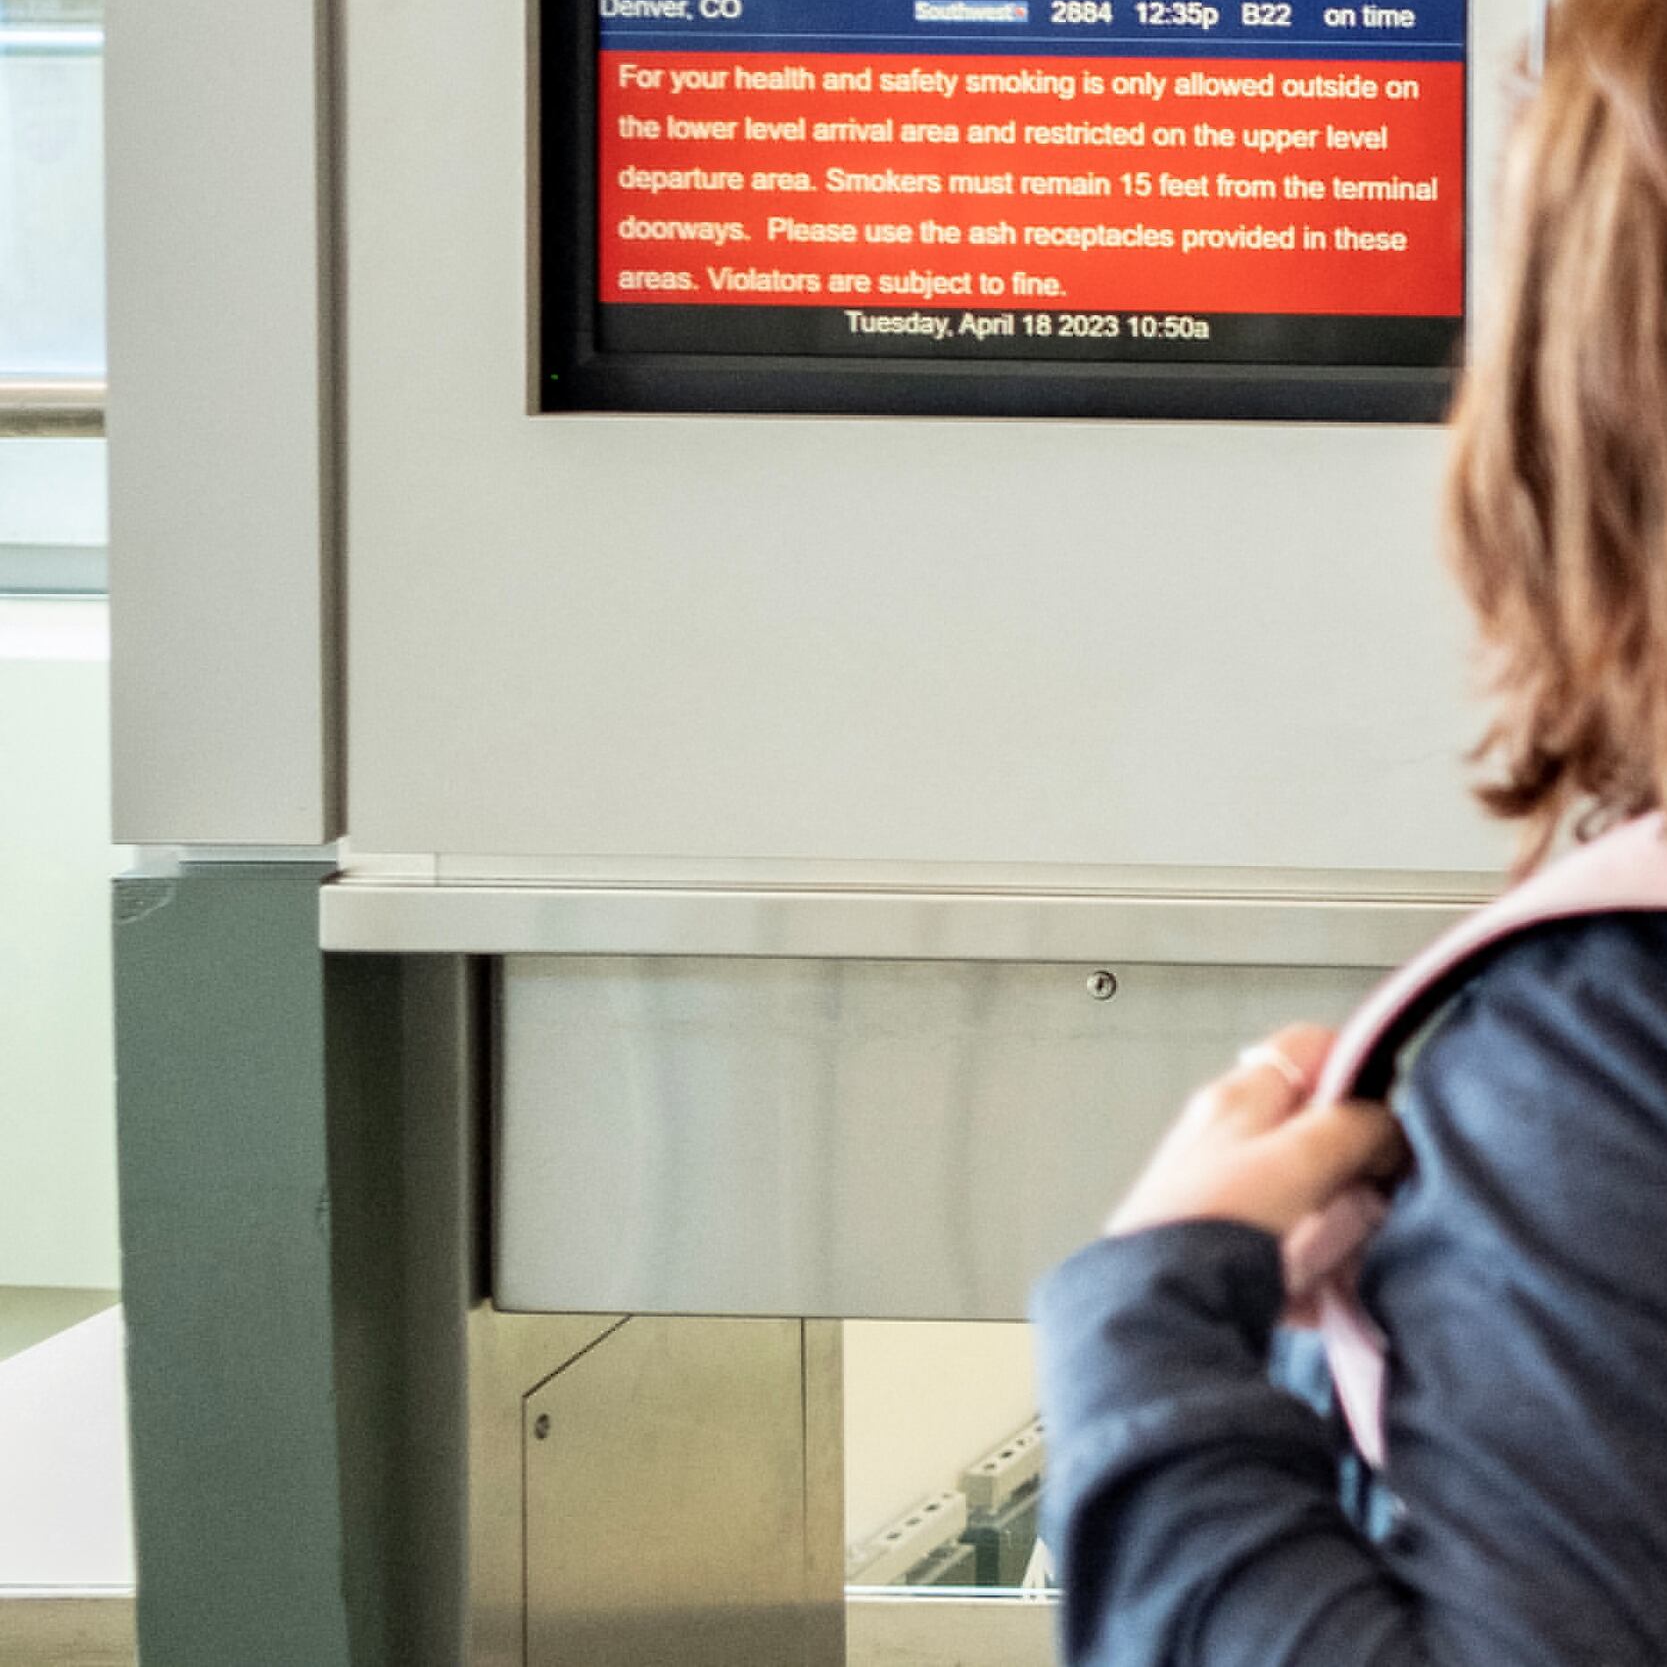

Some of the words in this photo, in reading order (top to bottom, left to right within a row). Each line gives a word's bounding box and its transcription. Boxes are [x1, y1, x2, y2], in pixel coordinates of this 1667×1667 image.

[619, 64, 664, 89] For
[670, 70, 730, 94] your
[734, 65, 816, 91] health
[822, 67, 873, 92] and
[879, 67, 959, 99] safety
[965, 69, 1076, 101] smoking
[1082, 70, 1105, 95] is
[1111, 71, 1167, 102] only
[1173, 71, 1275, 98] allowed
[1281, 73, 1379, 99] outside
[1385, 80, 1419, 99] on
[618, 115, 661, 139] the
[667, 115, 739, 140] lower
[744, 116, 806, 142] level
[812, 117, 894, 143] arrival
[899, 123, 960, 144] area
[966, 119, 1017, 145] and
[1023, 121, 1146, 147] restricted
[1151, 126, 1187, 147] on
[1193, 122, 1237, 148] the
[1242, 128, 1321, 154] upper
[1326, 124, 1388, 150] level
[618, 165, 745, 194] departure
[750, 171, 817, 192] area.
[825, 166, 943, 194] Smokers
[948, 171, 1015, 195] must
[1020, 171, 1112, 197] remain
[1119, 171, 1153, 197] 15
[1158, 171, 1210, 198] feet
[1215, 173, 1277, 199] from
[1283, 174, 1326, 200] the
[1332, 176, 1438, 201] terminal
[618, 215, 752, 247] doorways.
[767, 216, 859, 243] Please
[863, 223, 915, 244] use
[918, 218, 962, 245] the
[967, 220, 1017, 245] ash
[1023, 222, 1176, 252] receptacles
[1181, 224, 1296, 254] provided
[1303, 226, 1327, 250] in
[1334, 226, 1408, 252] these
[618, 271, 699, 290] areas.
[707, 266, 822, 293] Violators
[827, 273, 872, 294] are
[878, 269, 973, 300] subject
[978, 272, 1006, 296] to
[1011, 271, 1067, 297] fine.
[844, 310, 953, 340] Tuesday,
[958, 312, 1015, 341] April
[1022, 314, 1052, 337] 18
[1058, 314, 1120, 338] 2023
[1127, 315, 1210, 339] 10:50a
